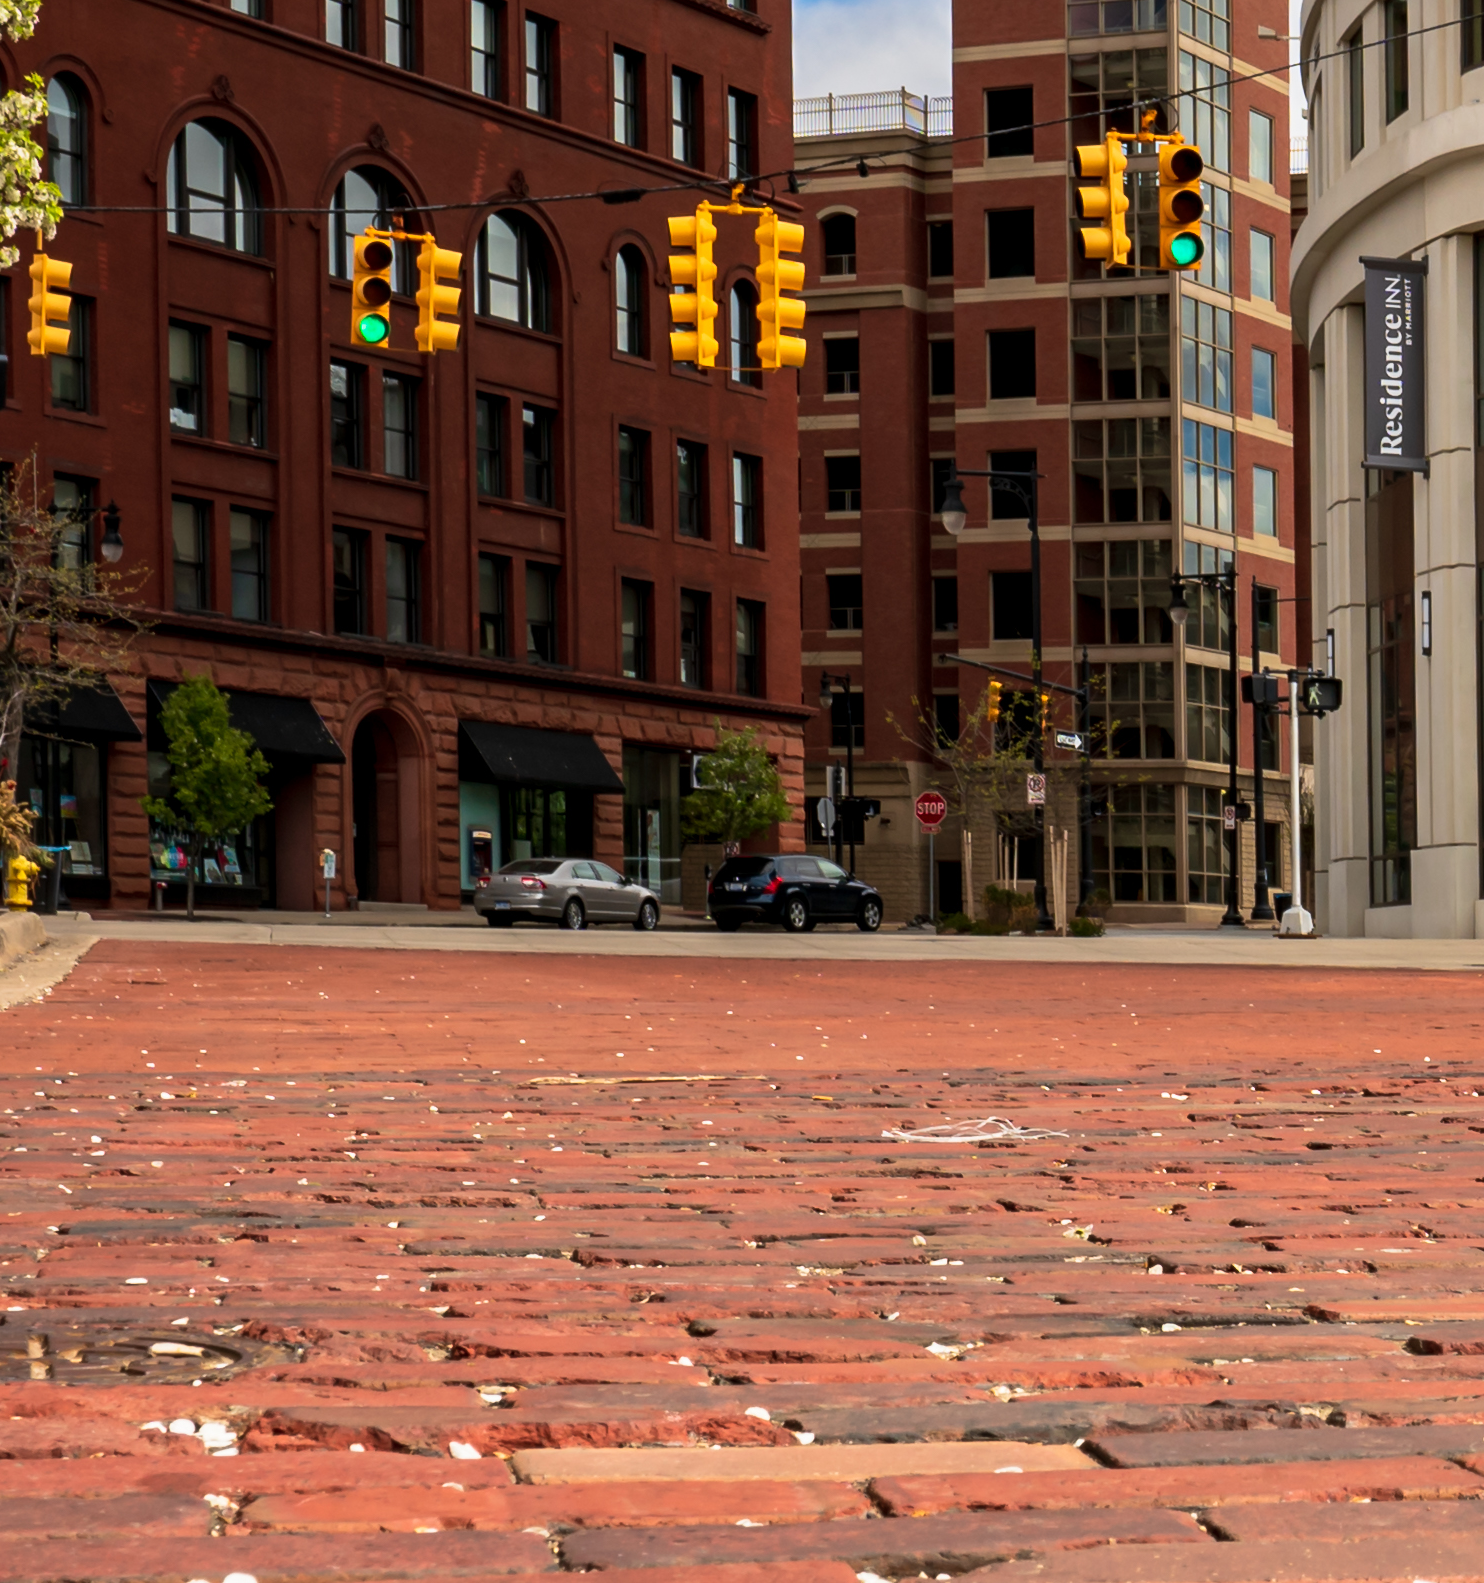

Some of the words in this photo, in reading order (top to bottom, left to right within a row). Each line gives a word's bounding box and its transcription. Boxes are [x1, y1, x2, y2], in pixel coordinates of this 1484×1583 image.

[1384, 277, 1401, 309] INN
[1404, 278, 1412, 330] MARRIOTT
[1405, 335, 1412, 346] BY
[1380, 313, 1403, 456] Residence
[917, 802, 944, 815] STOP
